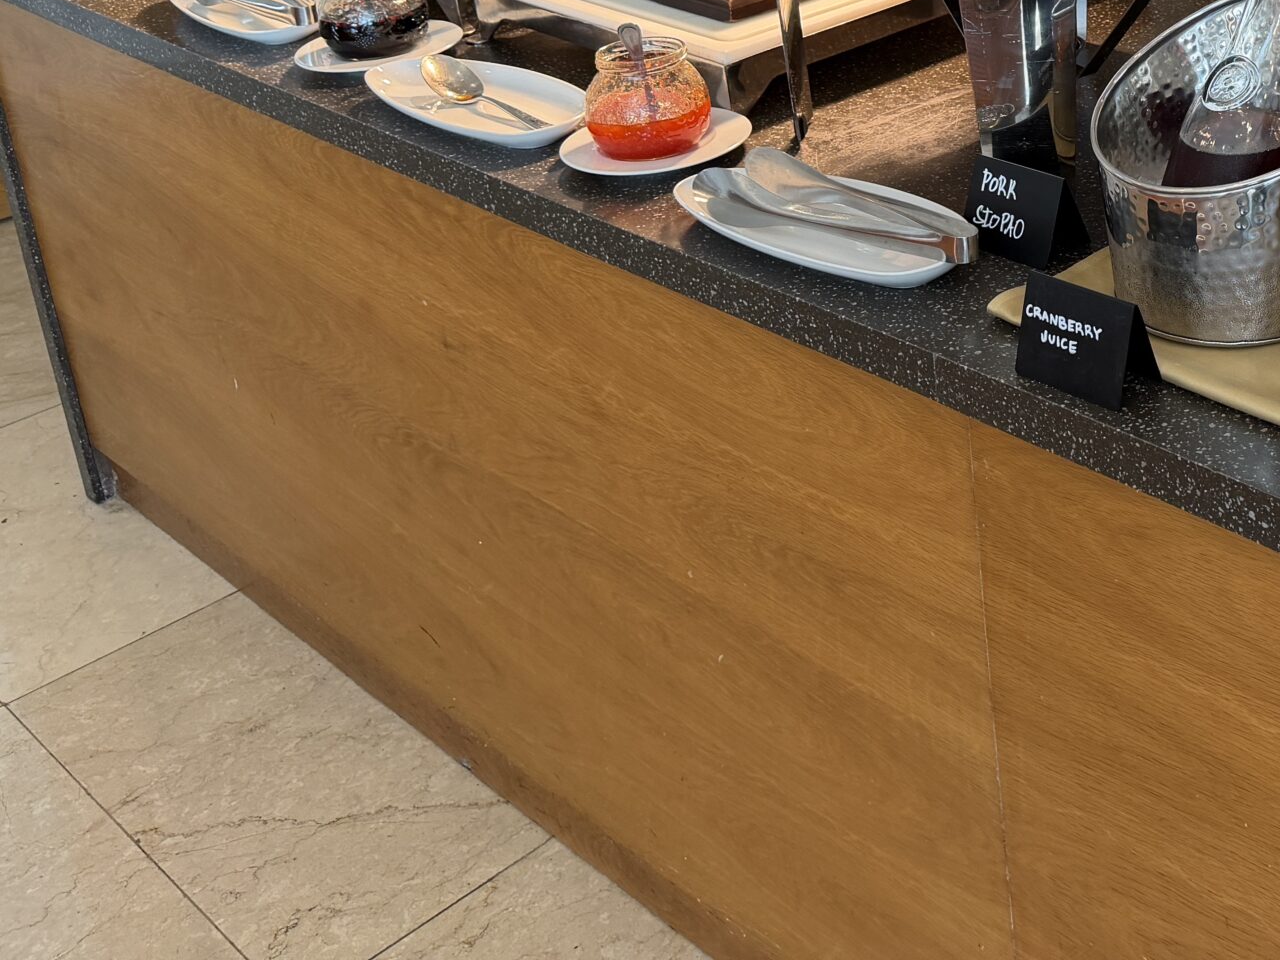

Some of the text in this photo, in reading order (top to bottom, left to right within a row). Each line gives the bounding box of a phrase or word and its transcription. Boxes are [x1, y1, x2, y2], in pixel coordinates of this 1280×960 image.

[981, 168, 1017, 201] PORK
[1025, 303, 1103, 341] CRANBERRY
[1040, 329, 1078, 355] JUICE
